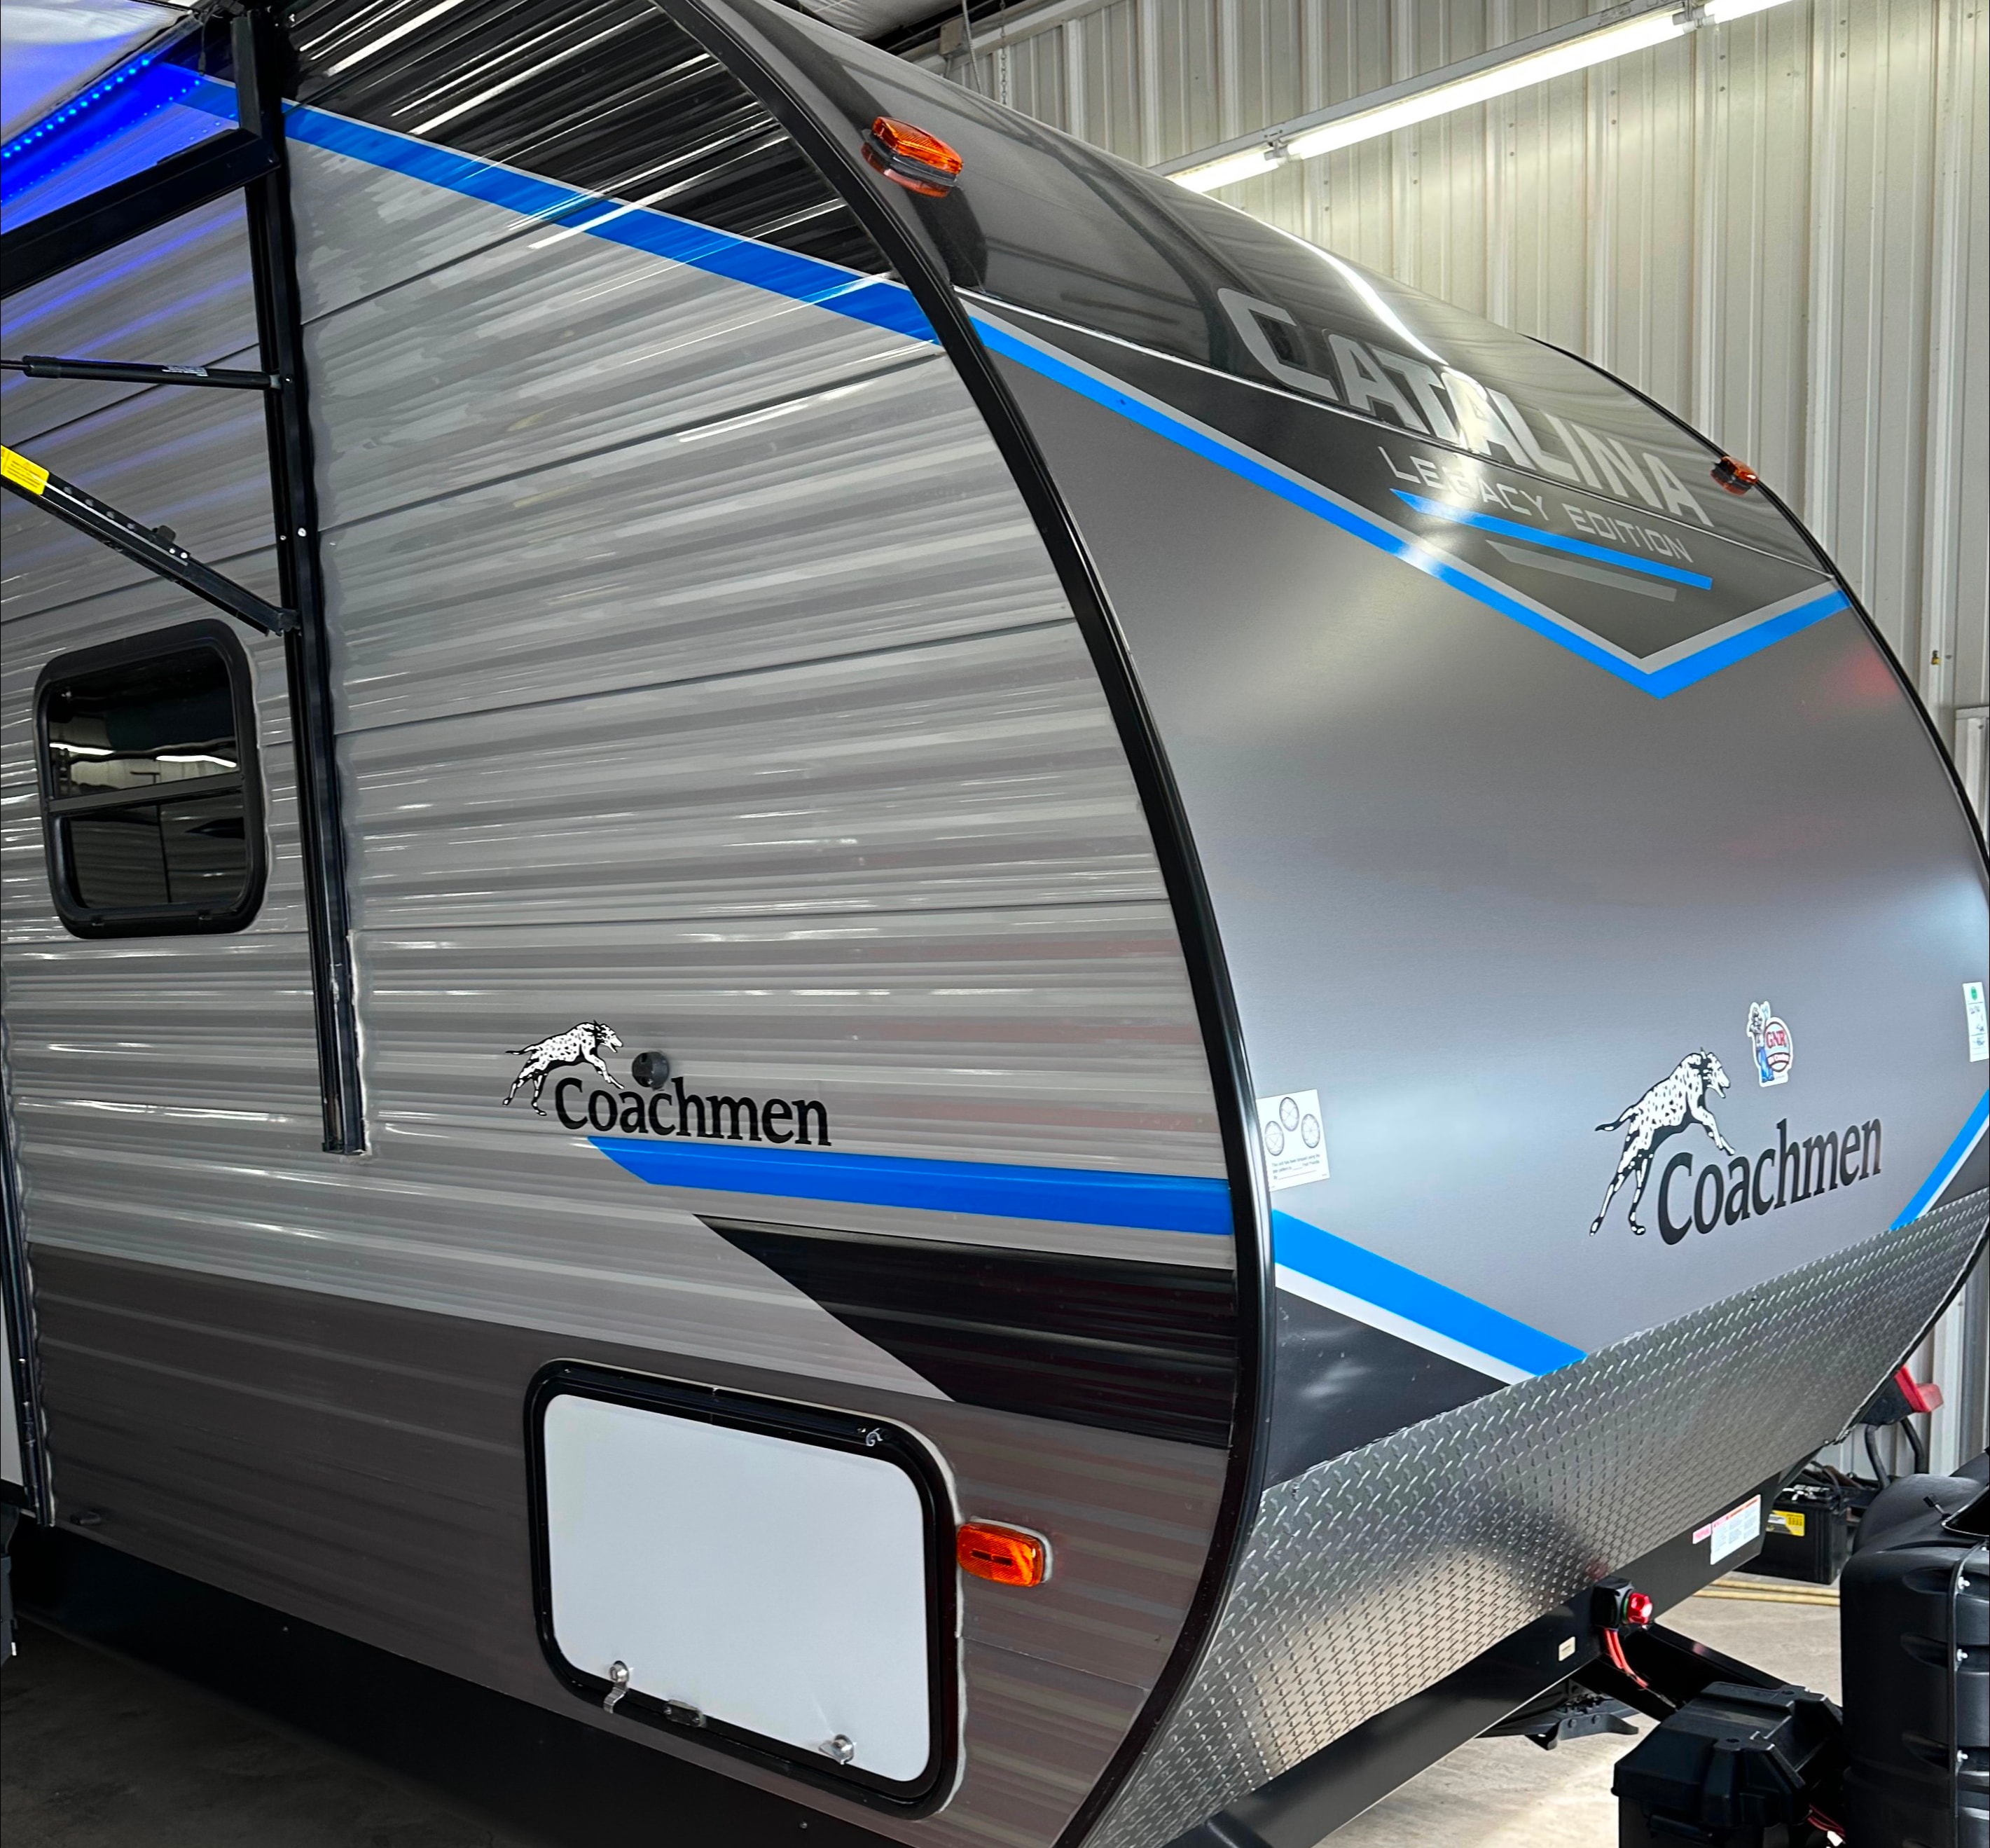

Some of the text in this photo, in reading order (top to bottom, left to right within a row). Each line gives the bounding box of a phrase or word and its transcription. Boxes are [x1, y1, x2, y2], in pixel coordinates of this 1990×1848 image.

[1217, 287, 1715, 527] CATALINA
[1378, 446, 1694, 563] LEGACY EDITION
[555, 1076, 832, 1147] Coachmen
[1657, 1117, 1881, 1246] Coachmen
